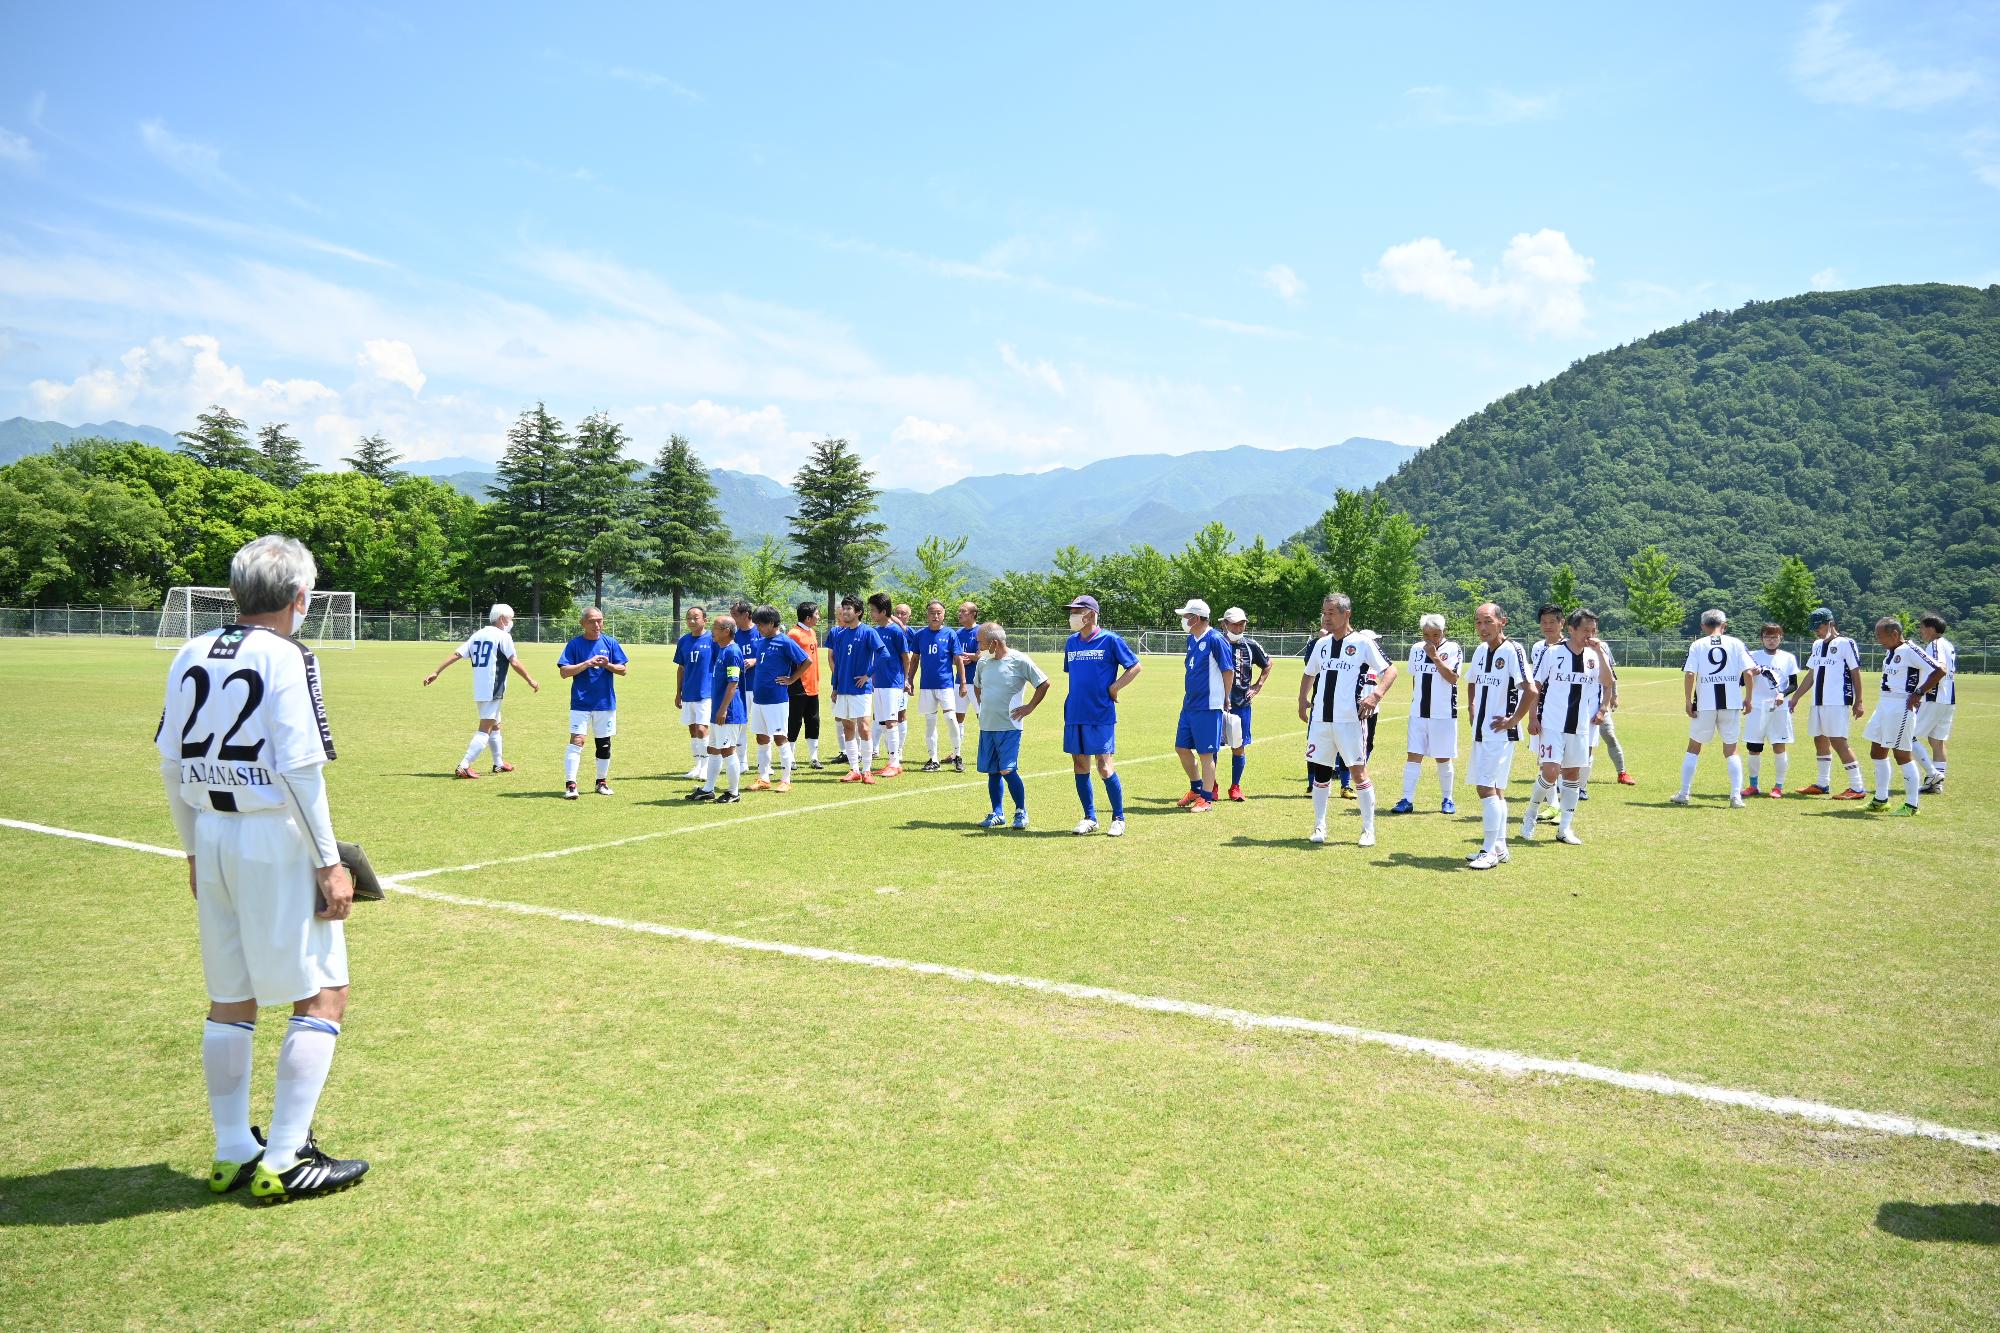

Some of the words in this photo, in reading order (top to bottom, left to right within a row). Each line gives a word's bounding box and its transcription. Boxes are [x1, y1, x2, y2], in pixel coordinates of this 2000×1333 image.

[472, 640, 494, 668] 39
[742, 644, 752, 655] 15
[847, 644, 853, 656] 3
[928, 643, 938, 655] 16
[690, 650, 700, 663] 17
[760, 652, 766, 664] 7
[1189, 656, 1195, 669] 4
[1478, 655, 1484, 670] 4
[1556, 656, 1565, 669] 7
[1707, 646, 1728, 676] 9
[1555, 672, 1576, 682] KAI
[180, 664, 266, 762] 22
[1540, 743, 1552, 758] 31
[180, 763, 273, 786] AANASHI
